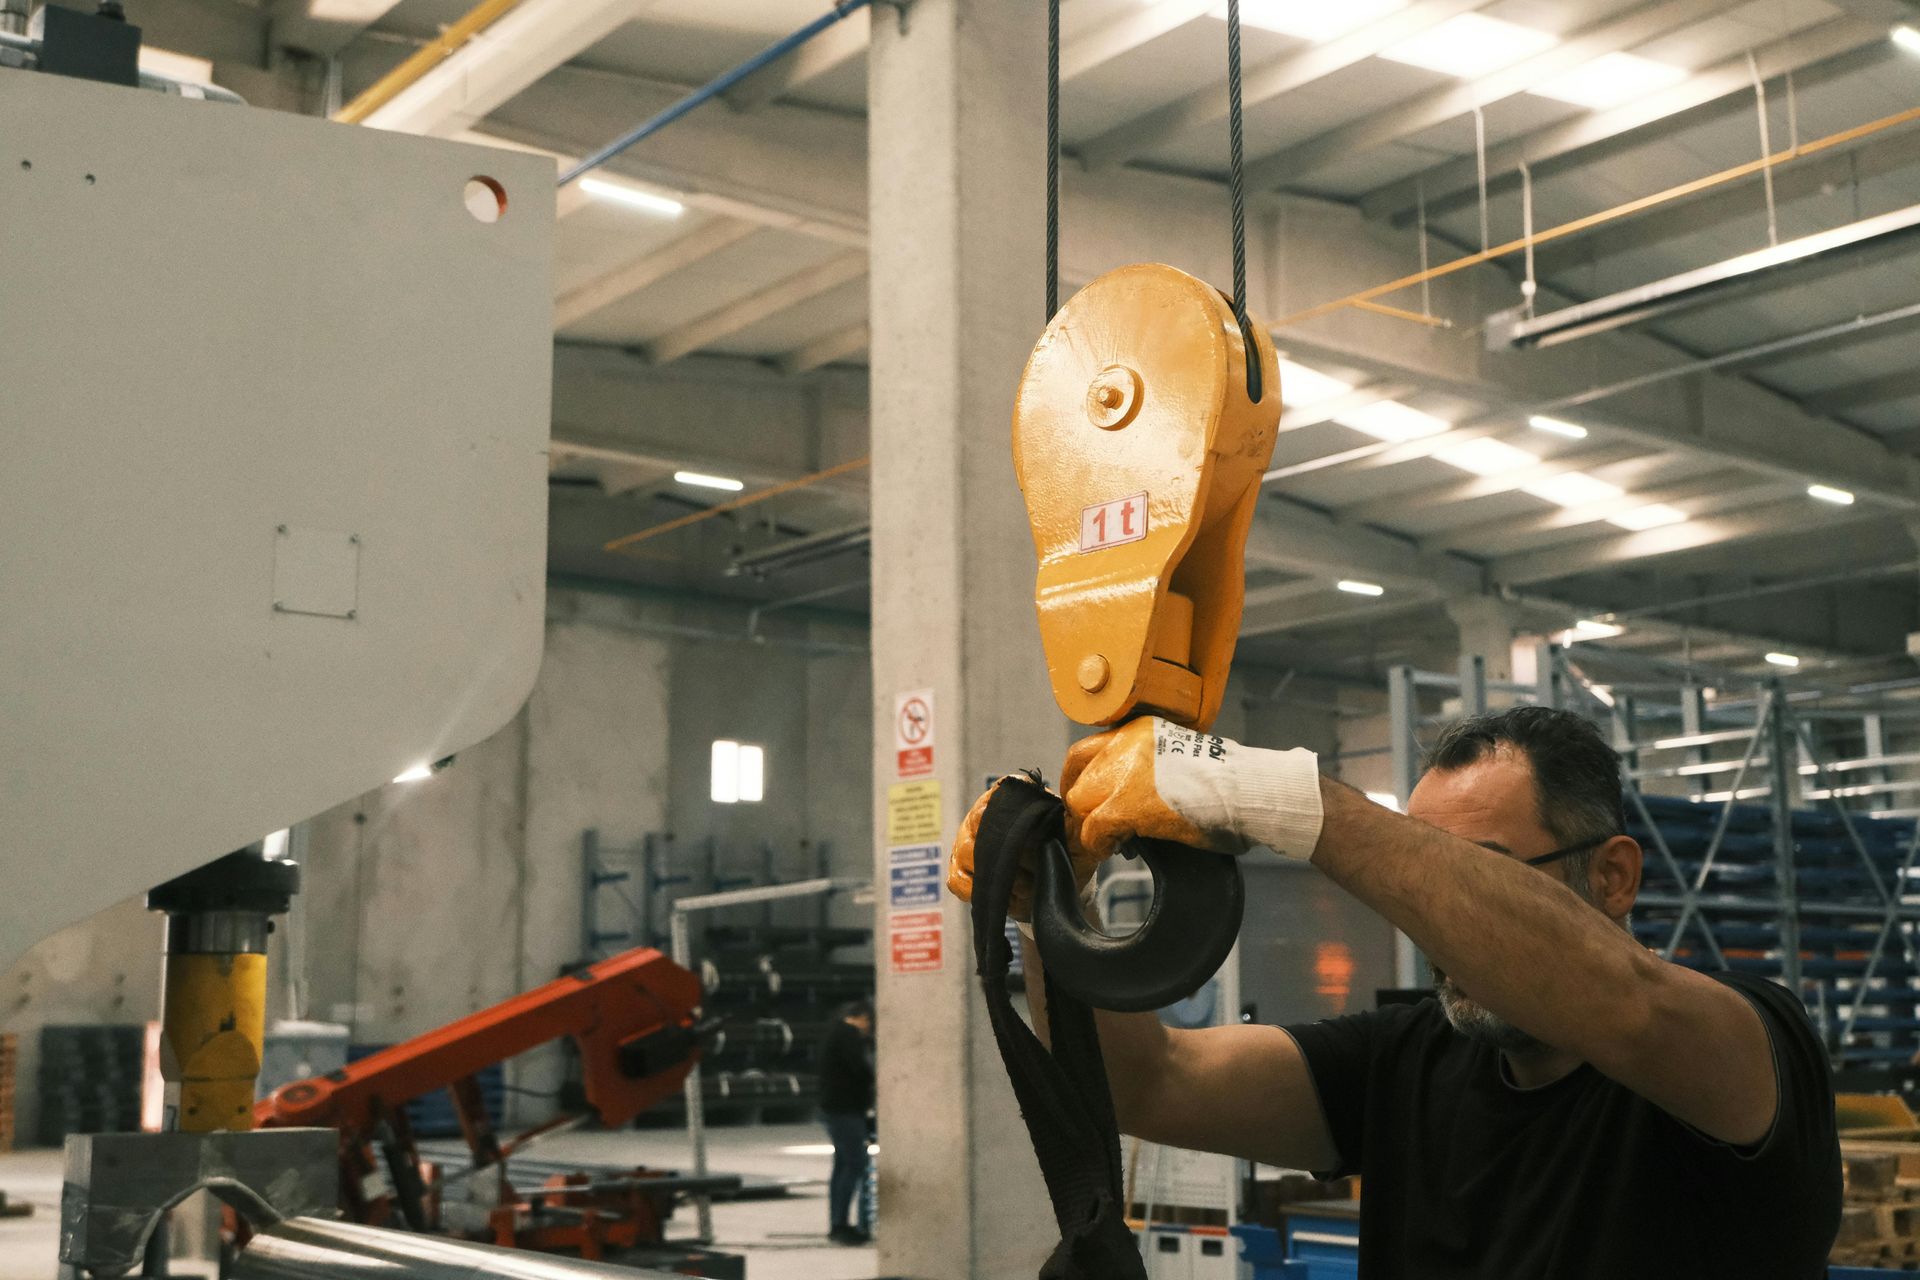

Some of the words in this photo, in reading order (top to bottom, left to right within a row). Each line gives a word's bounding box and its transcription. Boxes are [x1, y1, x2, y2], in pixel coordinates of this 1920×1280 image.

[1093, 508, 1105, 542] 1
[1121, 501, 1134, 535] t
[1171, 740, 1185, 754] CE
[1193, 744, 1202, 757] Flex
